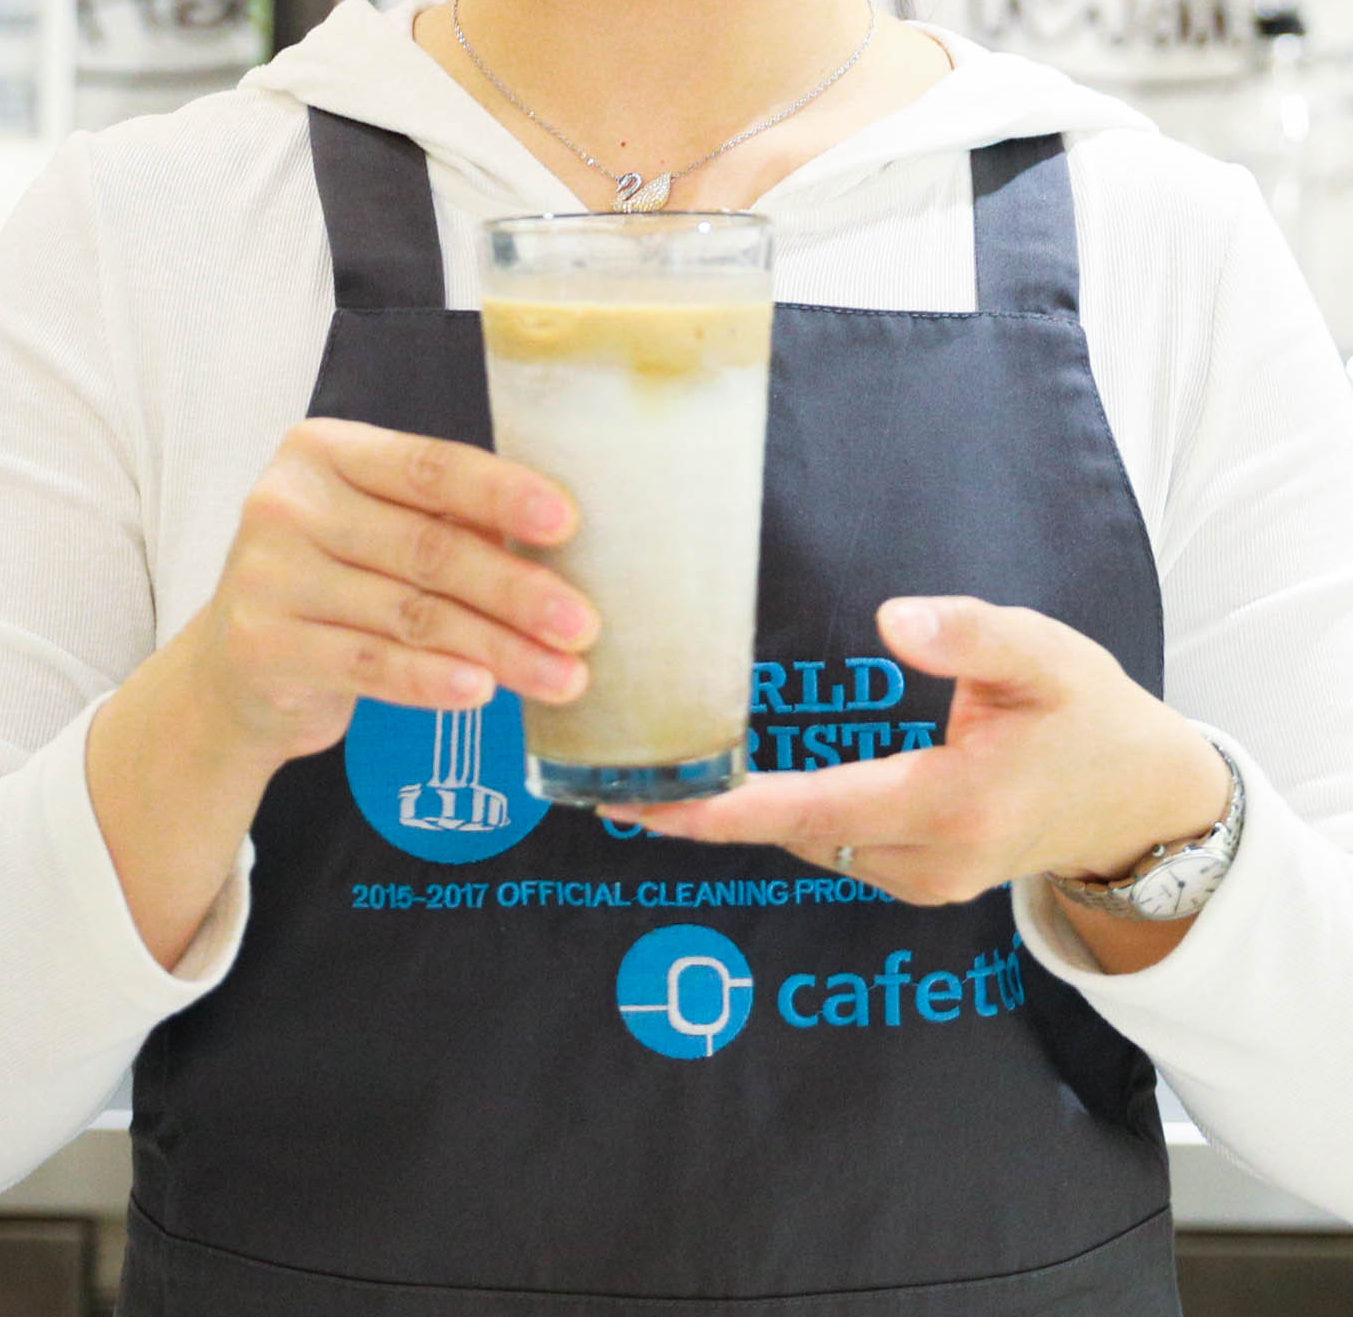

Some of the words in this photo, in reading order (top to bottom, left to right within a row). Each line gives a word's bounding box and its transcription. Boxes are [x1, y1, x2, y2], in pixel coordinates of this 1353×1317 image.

[752, 657, 905, 714] RLD
[497, 881, 631, 908] OFFICIAL
[637, 880, 789, 908] CLEANING
[777, 947, 1026, 1029] cafetto
